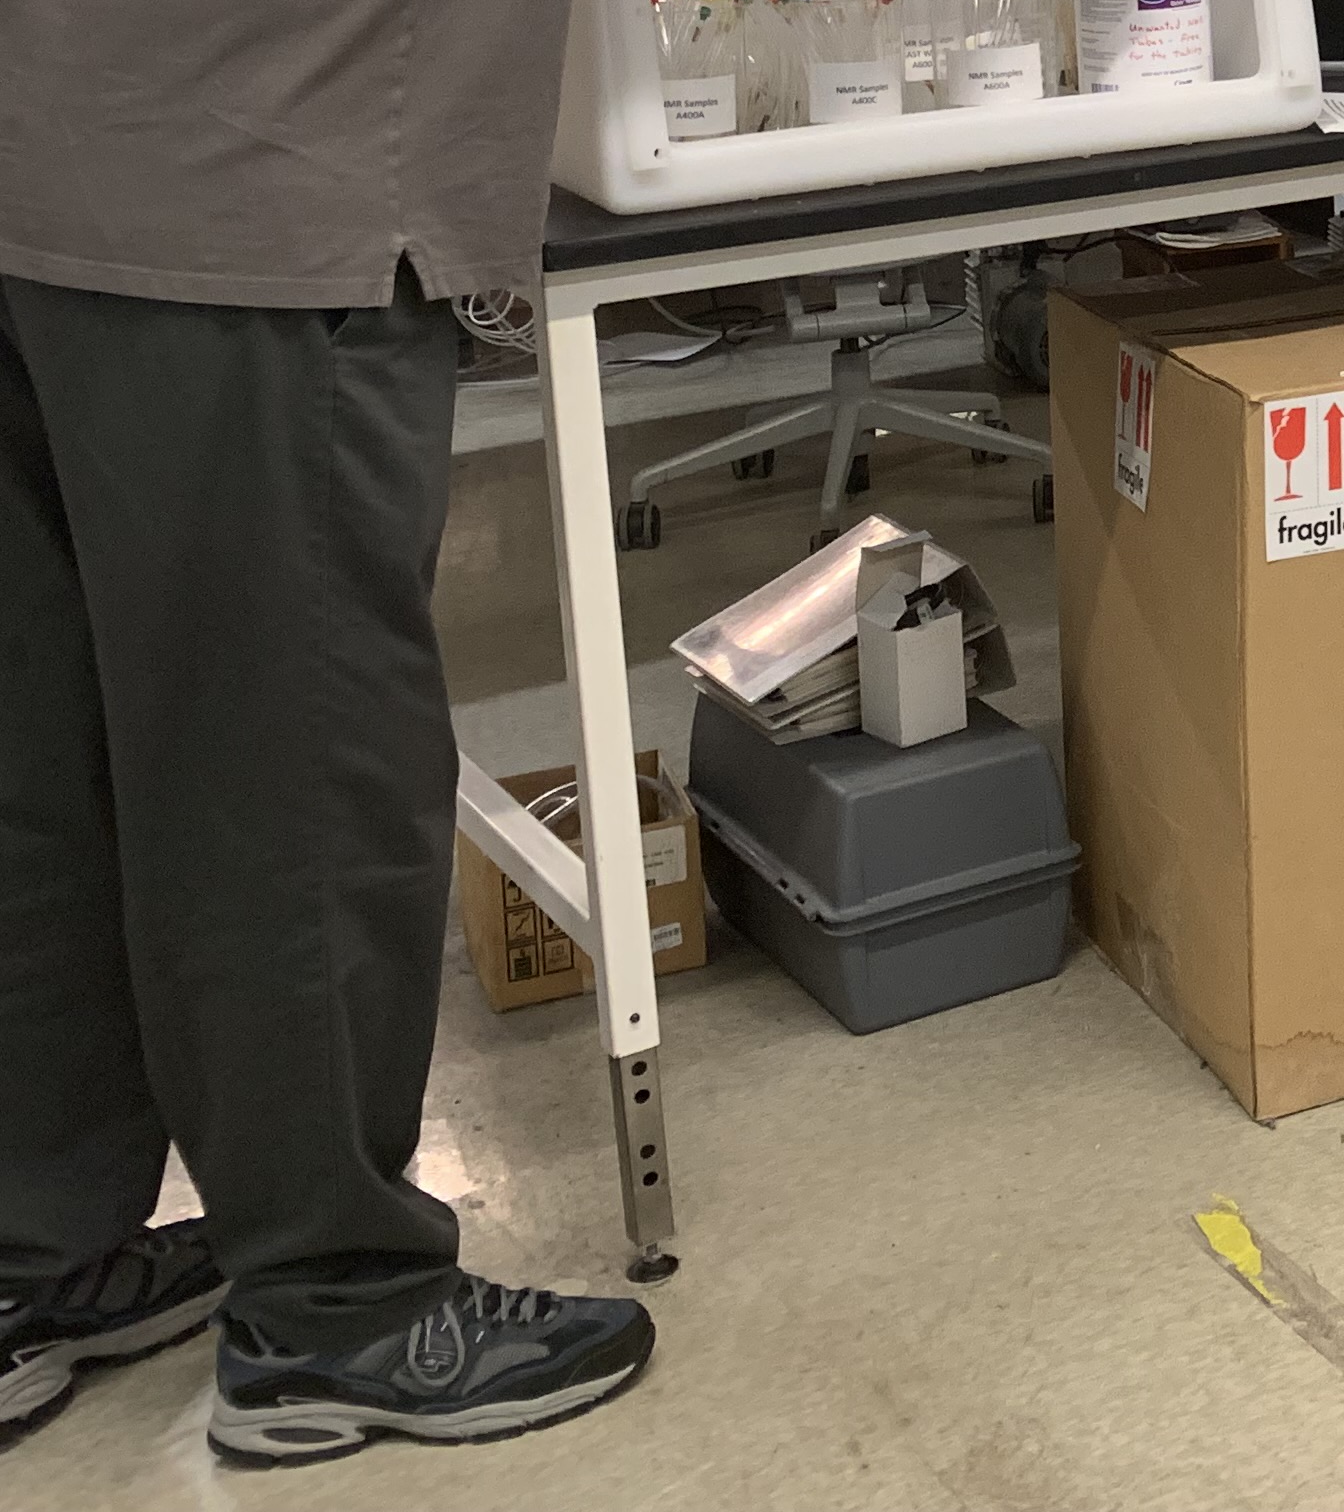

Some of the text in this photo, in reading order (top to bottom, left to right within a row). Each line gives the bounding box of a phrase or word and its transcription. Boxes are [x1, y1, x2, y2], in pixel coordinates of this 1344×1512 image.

[968, 69, 1023, 80] NMR Samples
[836, 83, 889, 95] NMR Samples
[684, 98, 718, 108] Samples
[1118, 452, 1145, 496] fragile
